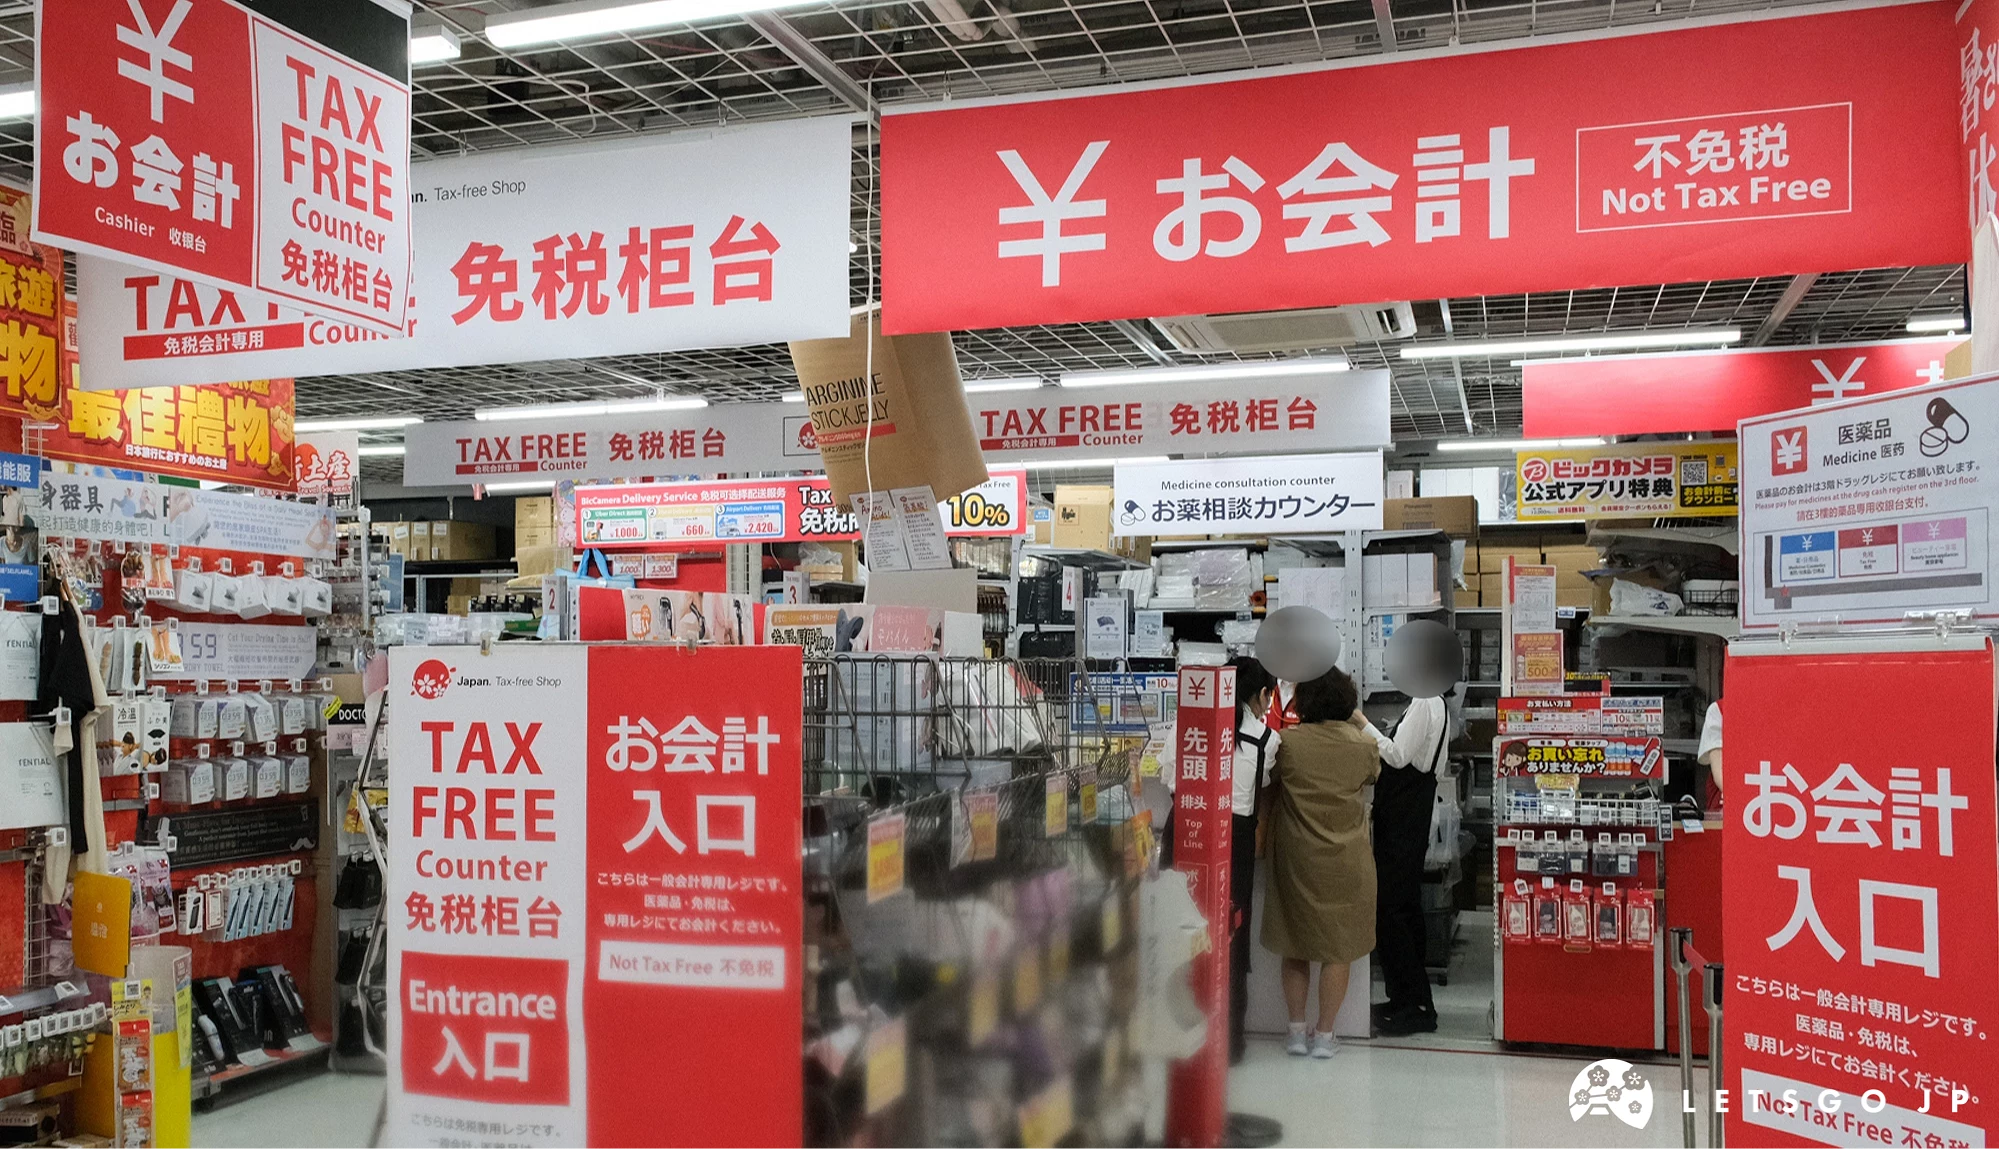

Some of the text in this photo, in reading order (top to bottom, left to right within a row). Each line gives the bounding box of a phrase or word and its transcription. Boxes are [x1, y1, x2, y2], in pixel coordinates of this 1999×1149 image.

[285, 54, 386, 154] TAX
[1634, 122, 1790, 180] 不免税
[62, 109, 240, 229] お会計
[281, 122, 394, 222] FREE
[434, 183, 488, 202] Tax-free
[491, 178, 526, 197] Shop
[1152, 126, 1536, 262] お会計
[1602, 175, 1832, 217] Not Tax Free
[95, 206, 156, 238] Cashier
[292, 197, 387, 254] Counter
[995, 140, 1111, 287] ¥
[169, 227, 206, 254] 收银台
[281, 239, 393, 313] 免税柜台
[450, 215, 781, 326] 免税柜台
[163, 330, 264, 356] 免税会計専用
[805, 373, 886, 407] ARGININE
[980, 403, 1143, 437] TAX FREE
[1170, 396, 1318, 436] 免税柜台
[1838, 418, 1892, 445] 医薬品
[455, 431, 588, 463] TAX FREE
[608, 427, 727, 463] 免税柜台
[1083, 433, 1144, 447] Counter
[540, 460, 588, 472] Counter
[1553, 457, 1673, 479] ビックカメラ
[1823, 449, 1877, 467] Medicine
[581, 491, 698, 506] BicCamera Delivery Service
[799, 485, 831, 505] Tax
[1161, 475, 1336, 491] Medicine consultation counter
[1524, 478, 1674, 501] 公式アプリ特典
[1755, 500, 1775, 510] Please
[1775, 499, 1787, 509] pay
[1788, 498, 1797, 506] for
[1798, 494, 1832, 506] medicines
[1841, 492, 1852, 500] the
[1853, 489, 1870, 500] drug
[1871, 487, 1887, 496] cash
[1888, 483, 1917, 497] register
[1929, 480, 1942, 489] the
[1944, 477, 1957, 487] 3rd
[1958, 475, 1979, 485] floor.
[948, 492, 1010, 528] 10%
[1151, 494, 1376, 523] お薬相談カウンター
[548, 588, 556, 610] 2
[789, 585, 797, 604] 3
[1066, 581, 1072, 605] 4
[456, 675, 562, 688] Japan. Tax-free Shop
[421, 720, 543, 776] TAX
[605, 715, 781, 776] お会計
[1182, 727, 1209, 781] 先頭
[1219, 727, 1232, 781] 先頭
[1527, 747, 1605, 762] お買い忘れ
[1527, 761, 1607, 774] ありませんか?
[412, 786, 557, 842] FREE
[1180, 794, 1207, 810] 排头
[1742, 760, 1969, 856] お会計
[622, 789, 757, 858] 入口
[1184, 818, 1203, 829] Top
[1188, 829, 1198, 838] of
[1183, 839, 1204, 850] Line
[415, 849, 548, 882] Counter
[597, 872, 788, 893] こちらは一般会計専用レジです。
[404, 890, 563, 939] 免税柜台
[603, 913, 782, 934] 専用レジにてお会計ください。
[1765, 864, 1940, 979] 入口
[609, 954, 775, 978] Not Tax Free 不免税
[408, 979, 557, 1020] Entrance
[1736, 974, 1987, 1041] こちらは一般会計専用レジです。
[1795, 1013, 1919, 1058] 医薬品・免税は、
[432, 1026, 531, 1083] 入口
[1743, 1032, 1980, 1104] 専用レジにてお会計ください。
[1758, 1091, 1796, 1119] No
[1799, 1100, 1839, 1130] Tax
[1843, 1112, 1893, 1145] Free
